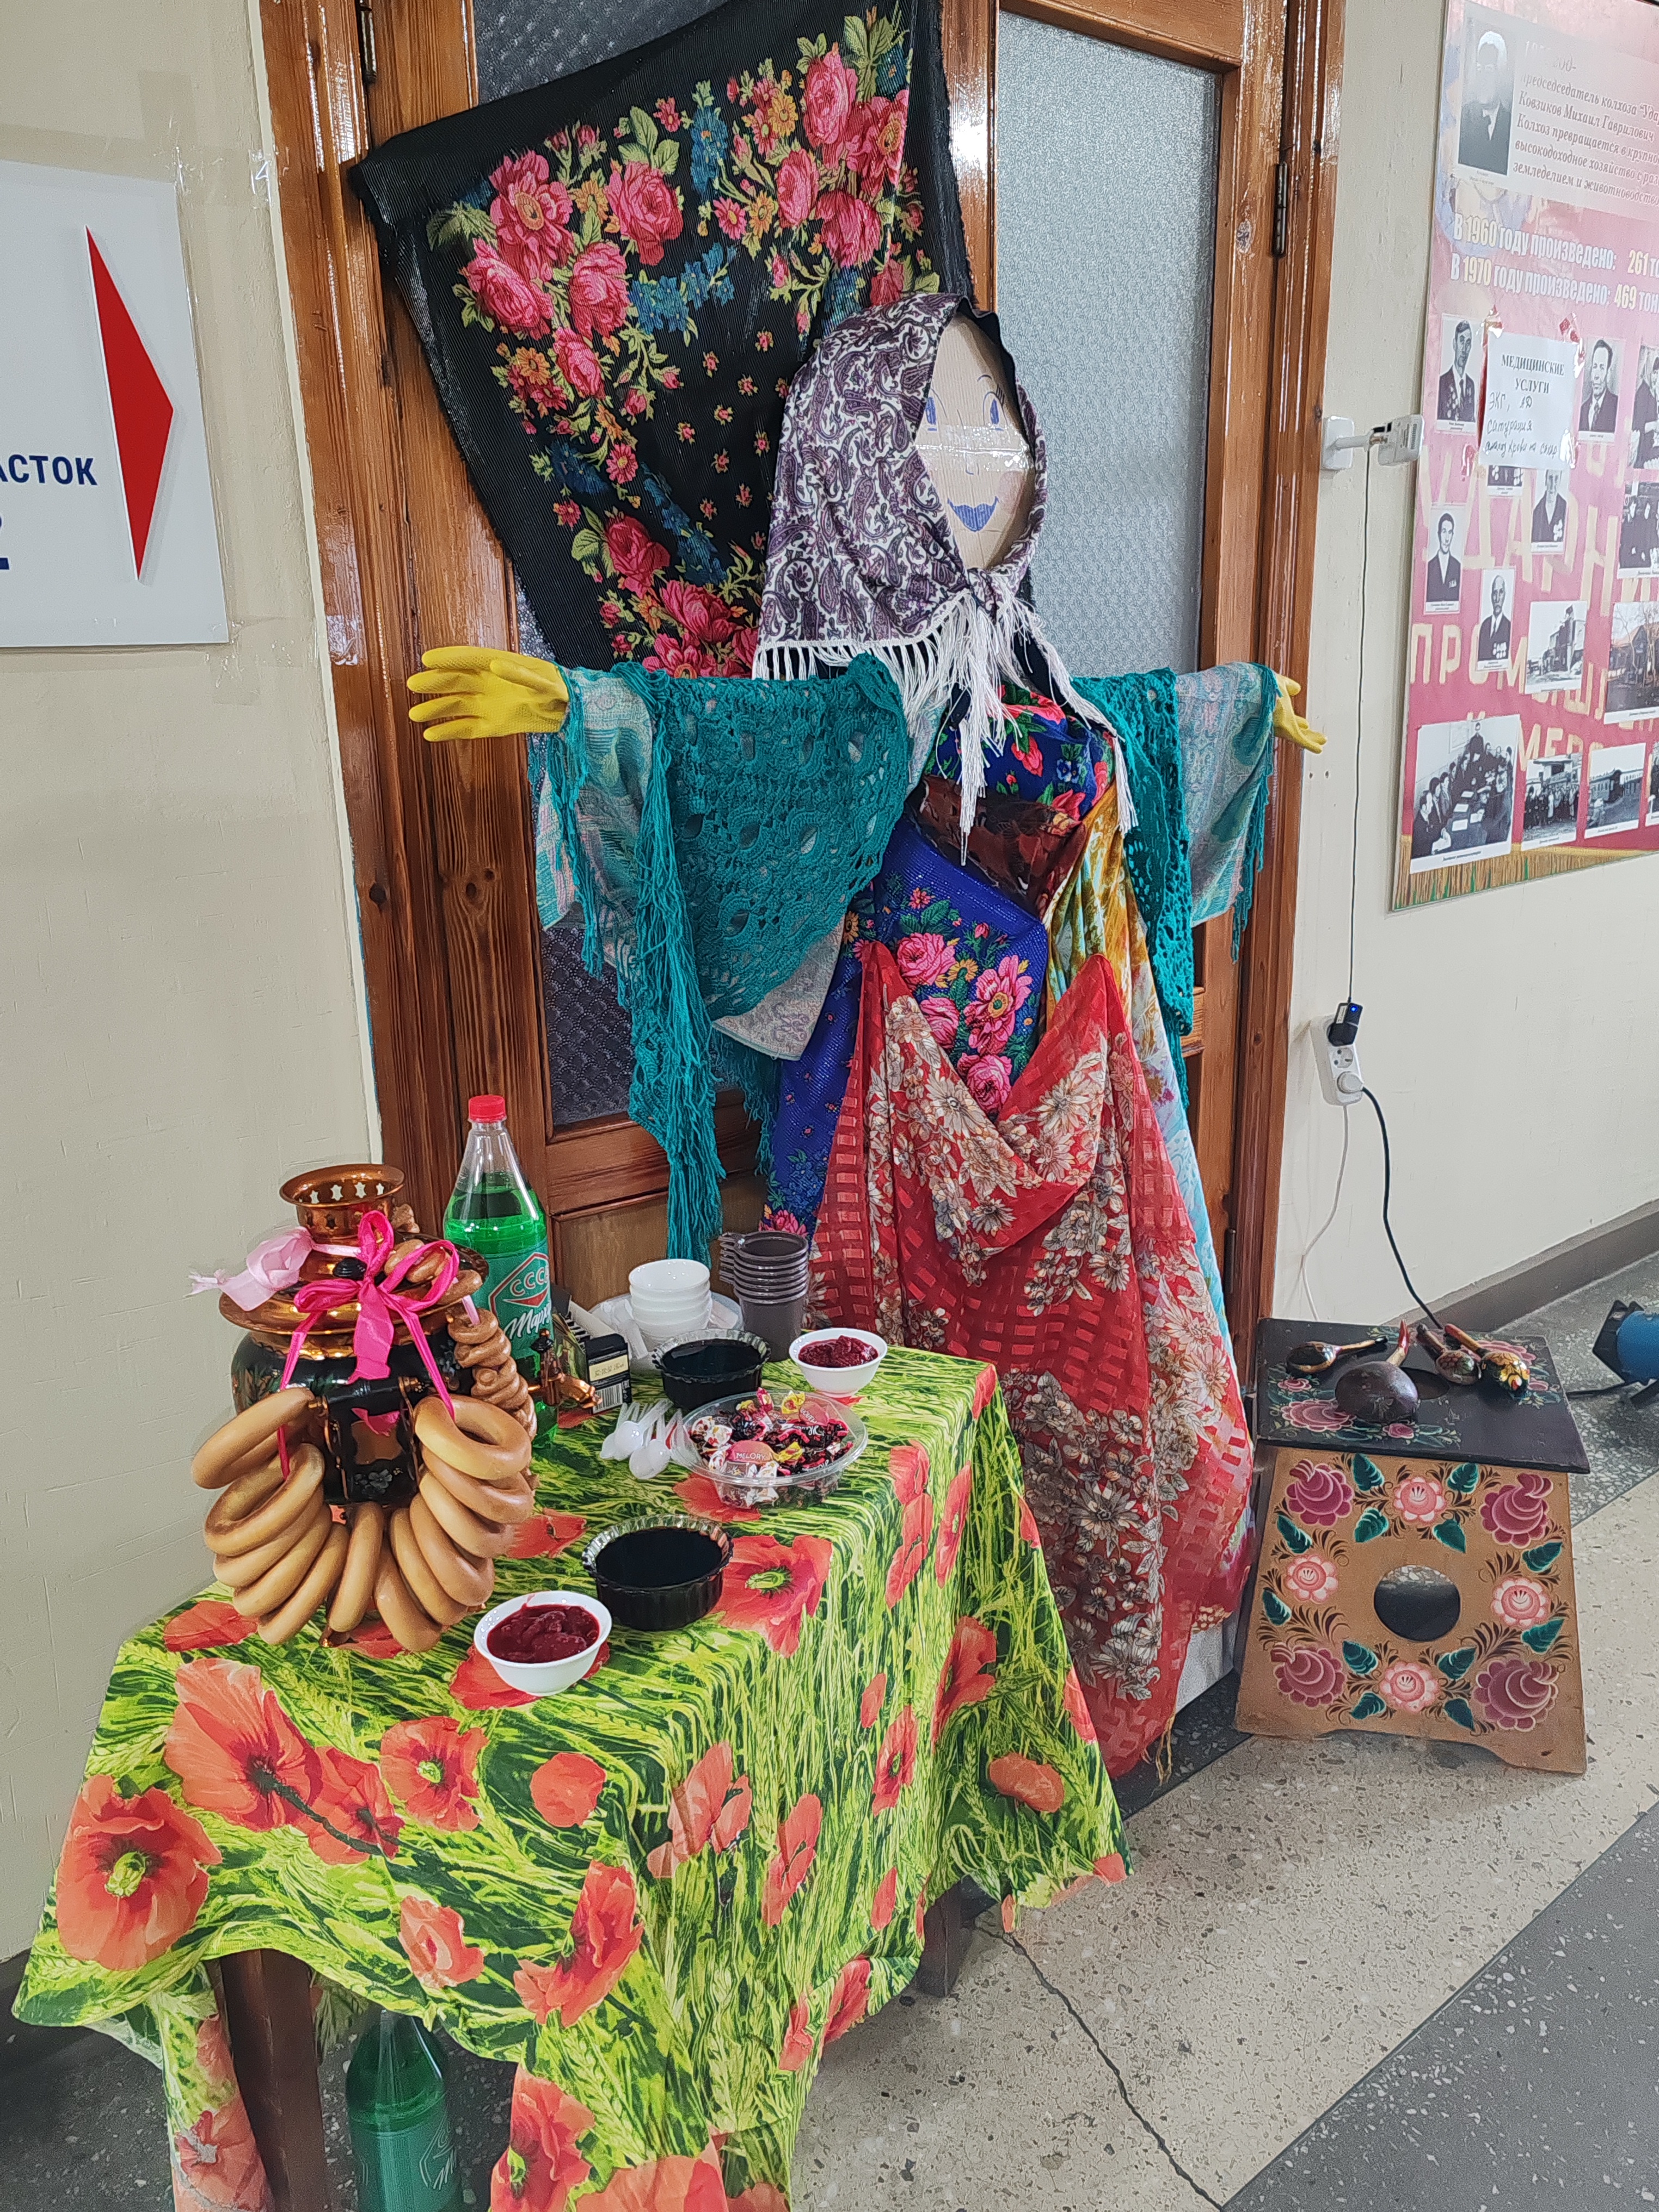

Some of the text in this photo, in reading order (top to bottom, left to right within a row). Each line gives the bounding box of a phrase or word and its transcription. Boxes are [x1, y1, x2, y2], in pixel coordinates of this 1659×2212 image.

[1519, 90, 1655, 142] Ковзиков Михаил Гаврилович
[1601, 96, 1637, 115] колхоза
[1516, 113, 1551, 136] Колхоз
[1551, 127, 1619, 154] превращается
[1620, 146, 1627, 156] в
[1513, 162, 1574, 186] земледелием
[1576, 177, 1583, 188] и
[1515, 139, 1659, 186] высокодоходное хозяйство с раз
[1453, 213, 1464, 240] В
[1464, 216, 1497, 247] 1960
[1498, 225, 1529, 256] году
[1530, 234, 1617, 271] произведено:
[1627, 249, 1649, 276] 261
[1451, 253, 1460, 280] В
[1463, 256, 1492, 286] 1970
[1494, 265, 1523, 294] году
[1525, 272, 1611, 306] произведено:
[1614, 284, 1637, 310] 469
[1501, 354, 1565, 376] МЕДИЦИНСКИЕ
[1515, 378, 1550, 394] УСЛУГИ
[736, 1452, 766, 1460] MELORY
